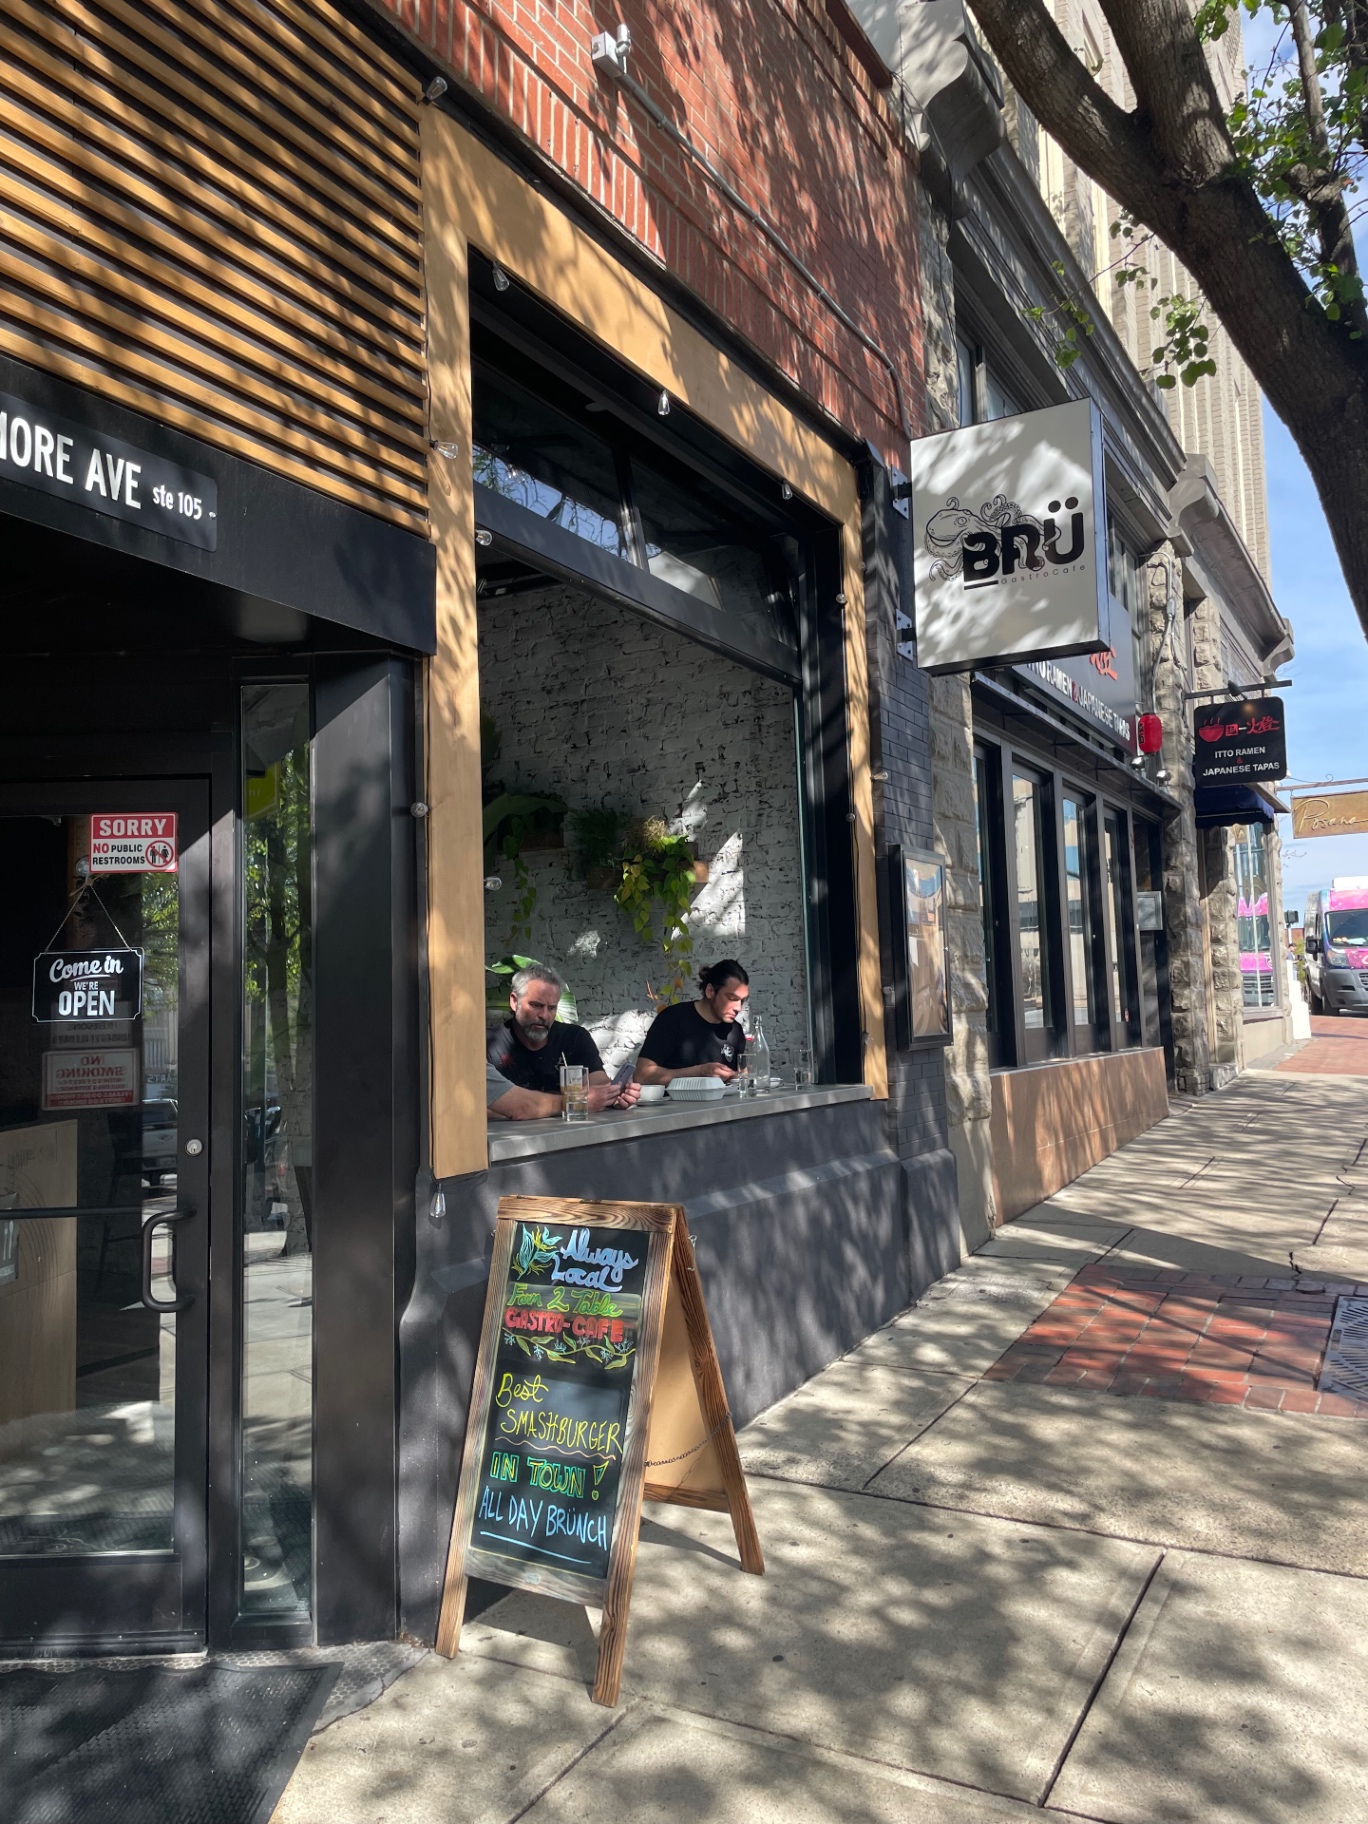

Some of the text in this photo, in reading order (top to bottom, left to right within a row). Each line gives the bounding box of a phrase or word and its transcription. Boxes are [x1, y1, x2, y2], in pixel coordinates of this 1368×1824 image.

[85, 448, 142, 509] AVE
[152, 484, 174, 510] ste
[178, 491, 202, 520] 105
[963, 496, 1085, 583] BRÜ
[1046, 660, 1072, 699] RAMEN
[1078, 685, 1113, 729] JAPANESE
[1214, 746, 1266, 759] ITTO RAMEN
[1202, 761, 1280, 777] JAPANESE TAPAS
[99, 818, 167, 837] SORRY
[92, 856, 146, 866] RESTROOMS
[93, 843, 143, 854] NO PUBLIC
[49, 955, 124, 983] Come in
[74, 980, 99, 991] WE'RE
[58, 990, 115, 1016] OPEN
[560, 1228, 638, 1283] Always
[551, 1255, 622, 1292] Local
[507, 1283, 623, 1317] Farm 2 Table
[495, 1373, 548, 1407] Best
[500, 1408, 623, 1454] SMASHBURGER
[490, 1452, 519, 1482] IN
[479, 1486, 607, 1551] ALL DAY BRÜNCH
